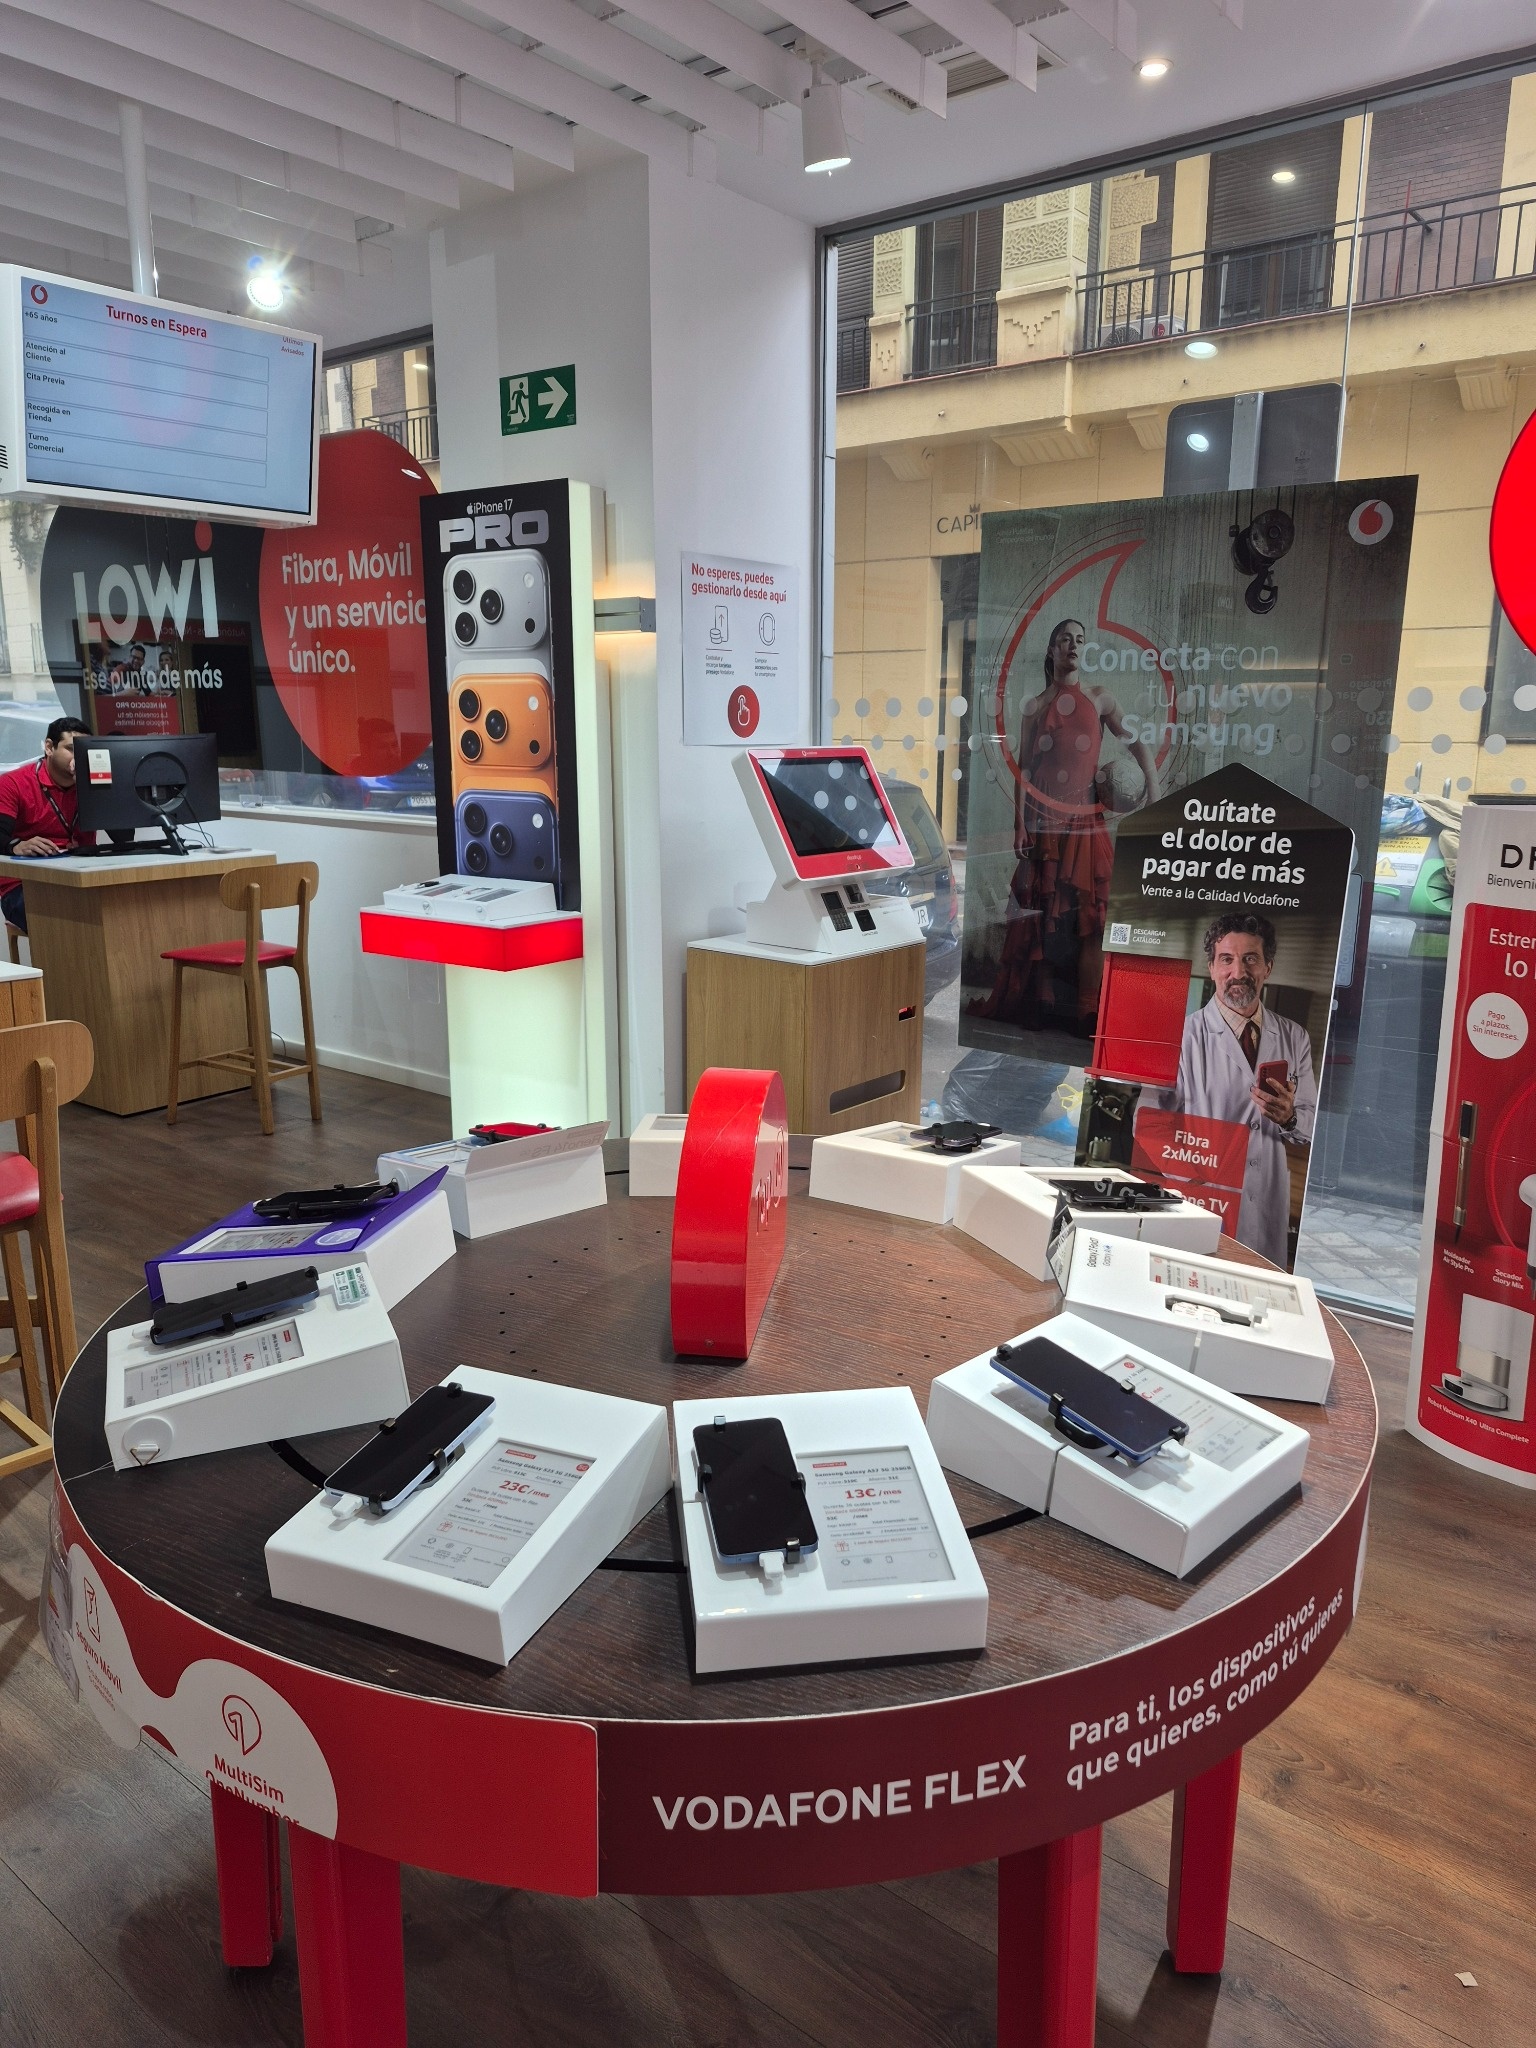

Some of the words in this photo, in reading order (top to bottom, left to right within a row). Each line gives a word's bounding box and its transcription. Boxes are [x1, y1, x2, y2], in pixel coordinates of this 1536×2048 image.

[24, 311, 38, 321] +65
[40, 313, 58, 324] años
[106, 305, 148, 327] Turnos
[151, 318, 166, 329] en
[169, 319, 207, 338] Espera
[26, 341, 57, 354] Atención
[60, 347, 66, 355] al
[26, 352, 51, 363] Cliente
[26, 372, 41, 382] Cita
[42, 374, 65, 385] Previa
[27, 402, 60, 416] Recogida
[62, 408, 71, 416] en
[27, 413, 52, 423] Tienda
[28, 433, 49, 442] Turno
[28, 443, 64, 454] Comercial
[473, 501, 503, 514] iPhone
[504, 499, 513, 511] 17
[439, 510, 549, 553] PRO
[282, 552, 344, 586] Fibra,
[349, 543, 412, 580] Móvil
[692, 563, 705, 577] No
[707, 568, 742, 583] esperes,
[744, 572, 774, 585] puedes
[692, 582, 741, 598] gestionarlo
[743, 586, 768, 601] desde
[769, 590, 787, 604] aquí
[285, 603, 300, 638] y
[303, 601, 331, 629] un
[289, 644, 355, 673] único.
[1081, 642, 1210, 672] Conecta
[1220, 645, 1279, 671] con
[83, 668, 107, 690] Ese
[111, 667, 156, 696] punto
[159, 664, 180, 689] de
[184, 661, 223, 689] más
[1147, 680, 1174, 708] tu
[1186, 683, 1293, 708] nuevo
[1121, 714, 1275, 756] Samsung
[1184, 798, 1276, 824] Quítate
[1161, 828, 1184, 849] el
[1189, 828, 1256, 852] dolor
[1260, 832, 1293, 854] de
[1142, 857, 1211, 882] pagar
[1215, 858, 1246, 881] de
[1252, 859, 1306, 885] más
[1487, 873, 1536, 890] Bienveni
[1141, 884, 1173, 897] Vente
[1175, 889, 1182, 898] a
[1184, 887, 1195, 899] la
[1197, 888, 1240, 903] Calidad
[1243, 892, 1300, 908] Vodafone
[1132, 936, 1161, 945] CATÁLOGO
[1133, 928, 1166, 937] DESCARGAR
[1505, 952, 1529, 978] lo
[1488, 1010, 1506, 1020] Pago
[1472, 1024, 1484, 1034] Sin
[1484, 1027, 1519, 1041] intereses.
[1486, 1020, 1511, 1031] plazos.
[1174, 1130, 1210, 1149] Fibra
[1161, 1145, 1218, 1168] 2xMóvil
[1208, 1197, 1230, 1214] TV
[1443, 1248, 1471, 1265] Moldeador
[1450, 1259, 1464, 1270] Style
[1464, 1264, 1474, 1274] Pro
[1495, 1268, 1522, 1282] Secador
[1492, 1276, 1510, 1287] Glory
[1512, 1280, 1524, 1290] Mix
[1427, 1396, 1442, 1410] Robot
[1443, 1405, 1465, 1420] Vacuum
[1465, 1416, 1478, 1426] X40
[1479, 1421, 1495, 1433] Ultra
[1496, 1428, 1530, 1444] Complete
[498, 1458, 523, 1467] Samsung
[524, 1463, 542, 1472] Galaxy
[499, 1480, 530, 1494] 23€
[845, 1488, 876, 1499] 13€
[76, 1622, 99, 1664] Seguro
[100, 1656, 122, 1694] Móvil
[1069, 1711, 1129, 1750] Para
[1136, 1694, 1161, 1725] ti,
[1168, 1676, 1204, 1711] los
[1210, 1595, 1316, 1690] dispositivos
[1067, 1751, 1120, 1791] que
[1126, 1703, 1221, 1767] quieres,
[1226, 1662, 1278, 1712] como
[1282, 1636, 1298, 1671] tú
[1301, 1588, 1344, 1654] quieres
[214, 1753, 284, 1803] MultiSim
[652, 1779, 912, 1831] VODAFONE
[925, 1754, 1027, 1809] FLEX
